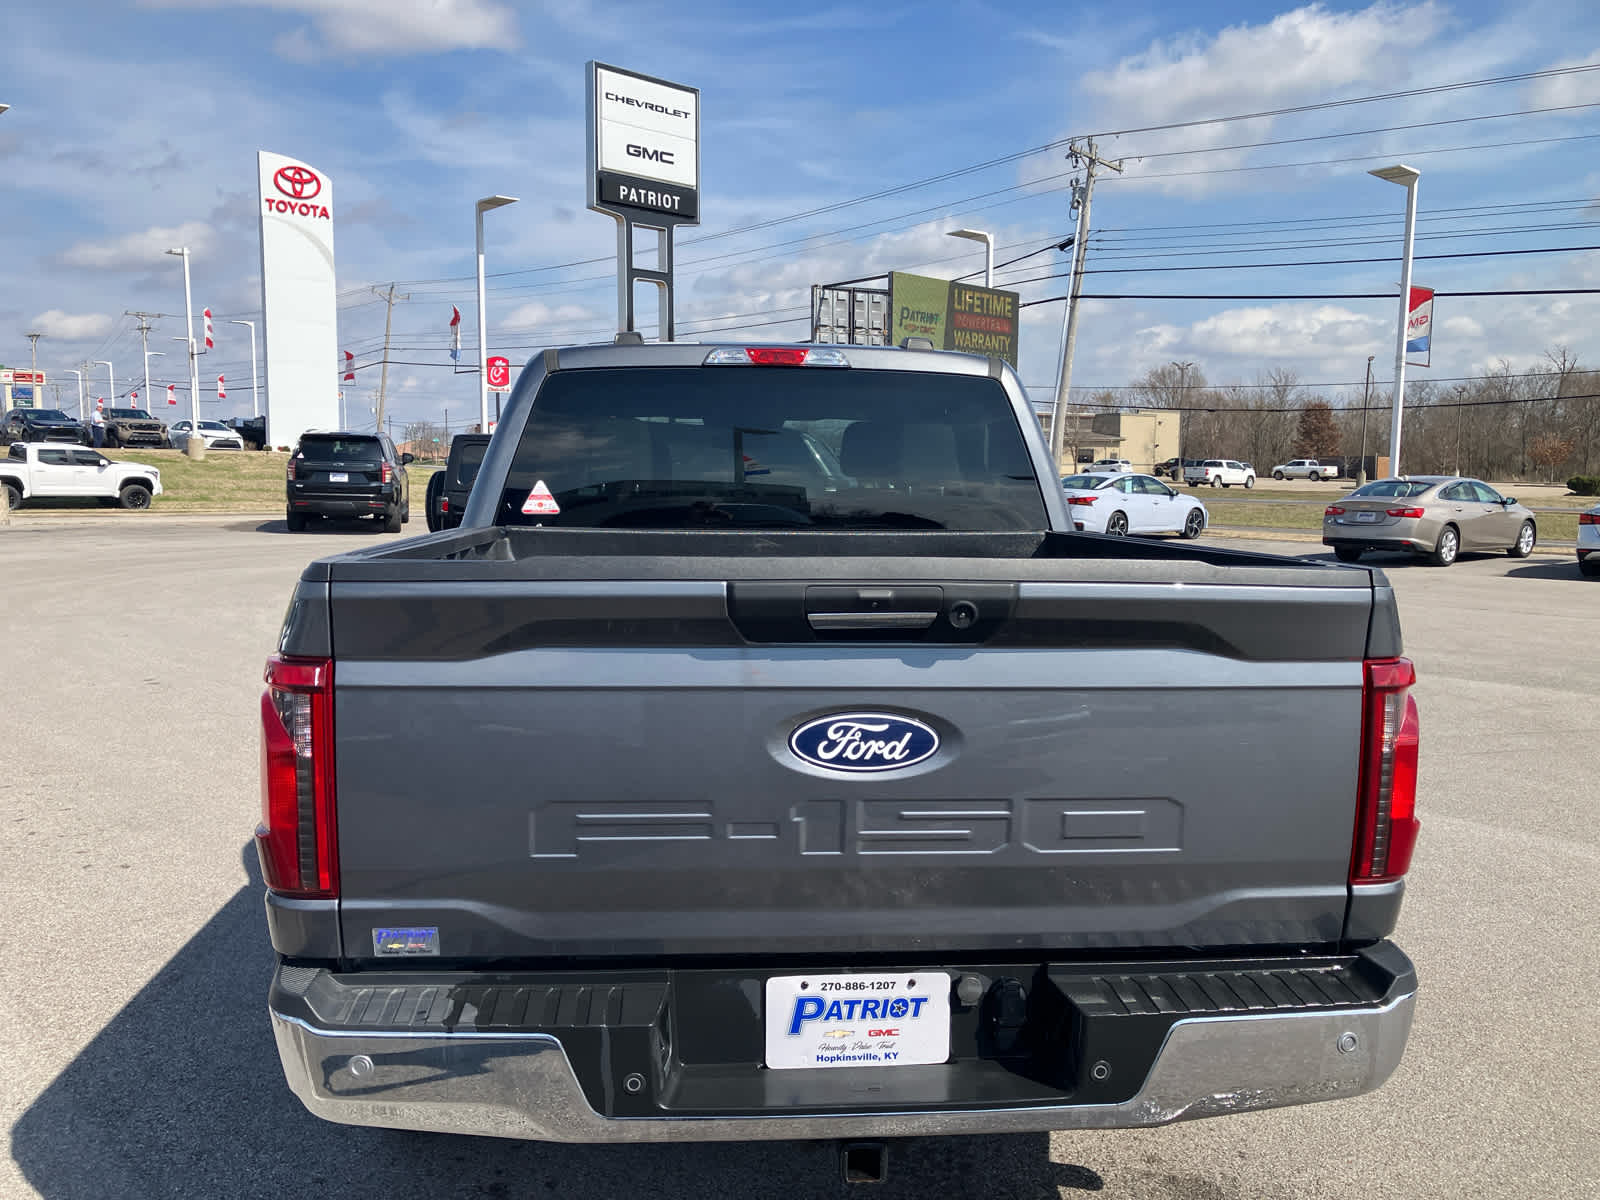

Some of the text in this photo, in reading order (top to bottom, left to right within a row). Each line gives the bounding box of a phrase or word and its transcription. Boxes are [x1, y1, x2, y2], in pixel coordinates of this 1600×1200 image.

[605, 92, 691, 119] CHEVROLET
[626, 144, 675, 165] GMC
[619, 185, 681, 210] PATRIOT
[265, 198, 330, 220] TOYOTA
[954, 287, 1013, 319] LIFETIME
[899, 306, 939, 328] PATRIOT
[954, 329, 1011, 352] WARRANTY
[817, 721, 913, 761] Ford
[529, 799, 1184, 858] F-150
[376, 929, 436, 945] PATRIOT
[820, 981, 897, 992] 270-886-1207
[787, 996, 929, 1036] PATRIOT
[868, 1028, 900, 1037] GMC
[816, 1051, 899, 1063] Hopkinsville, KY
